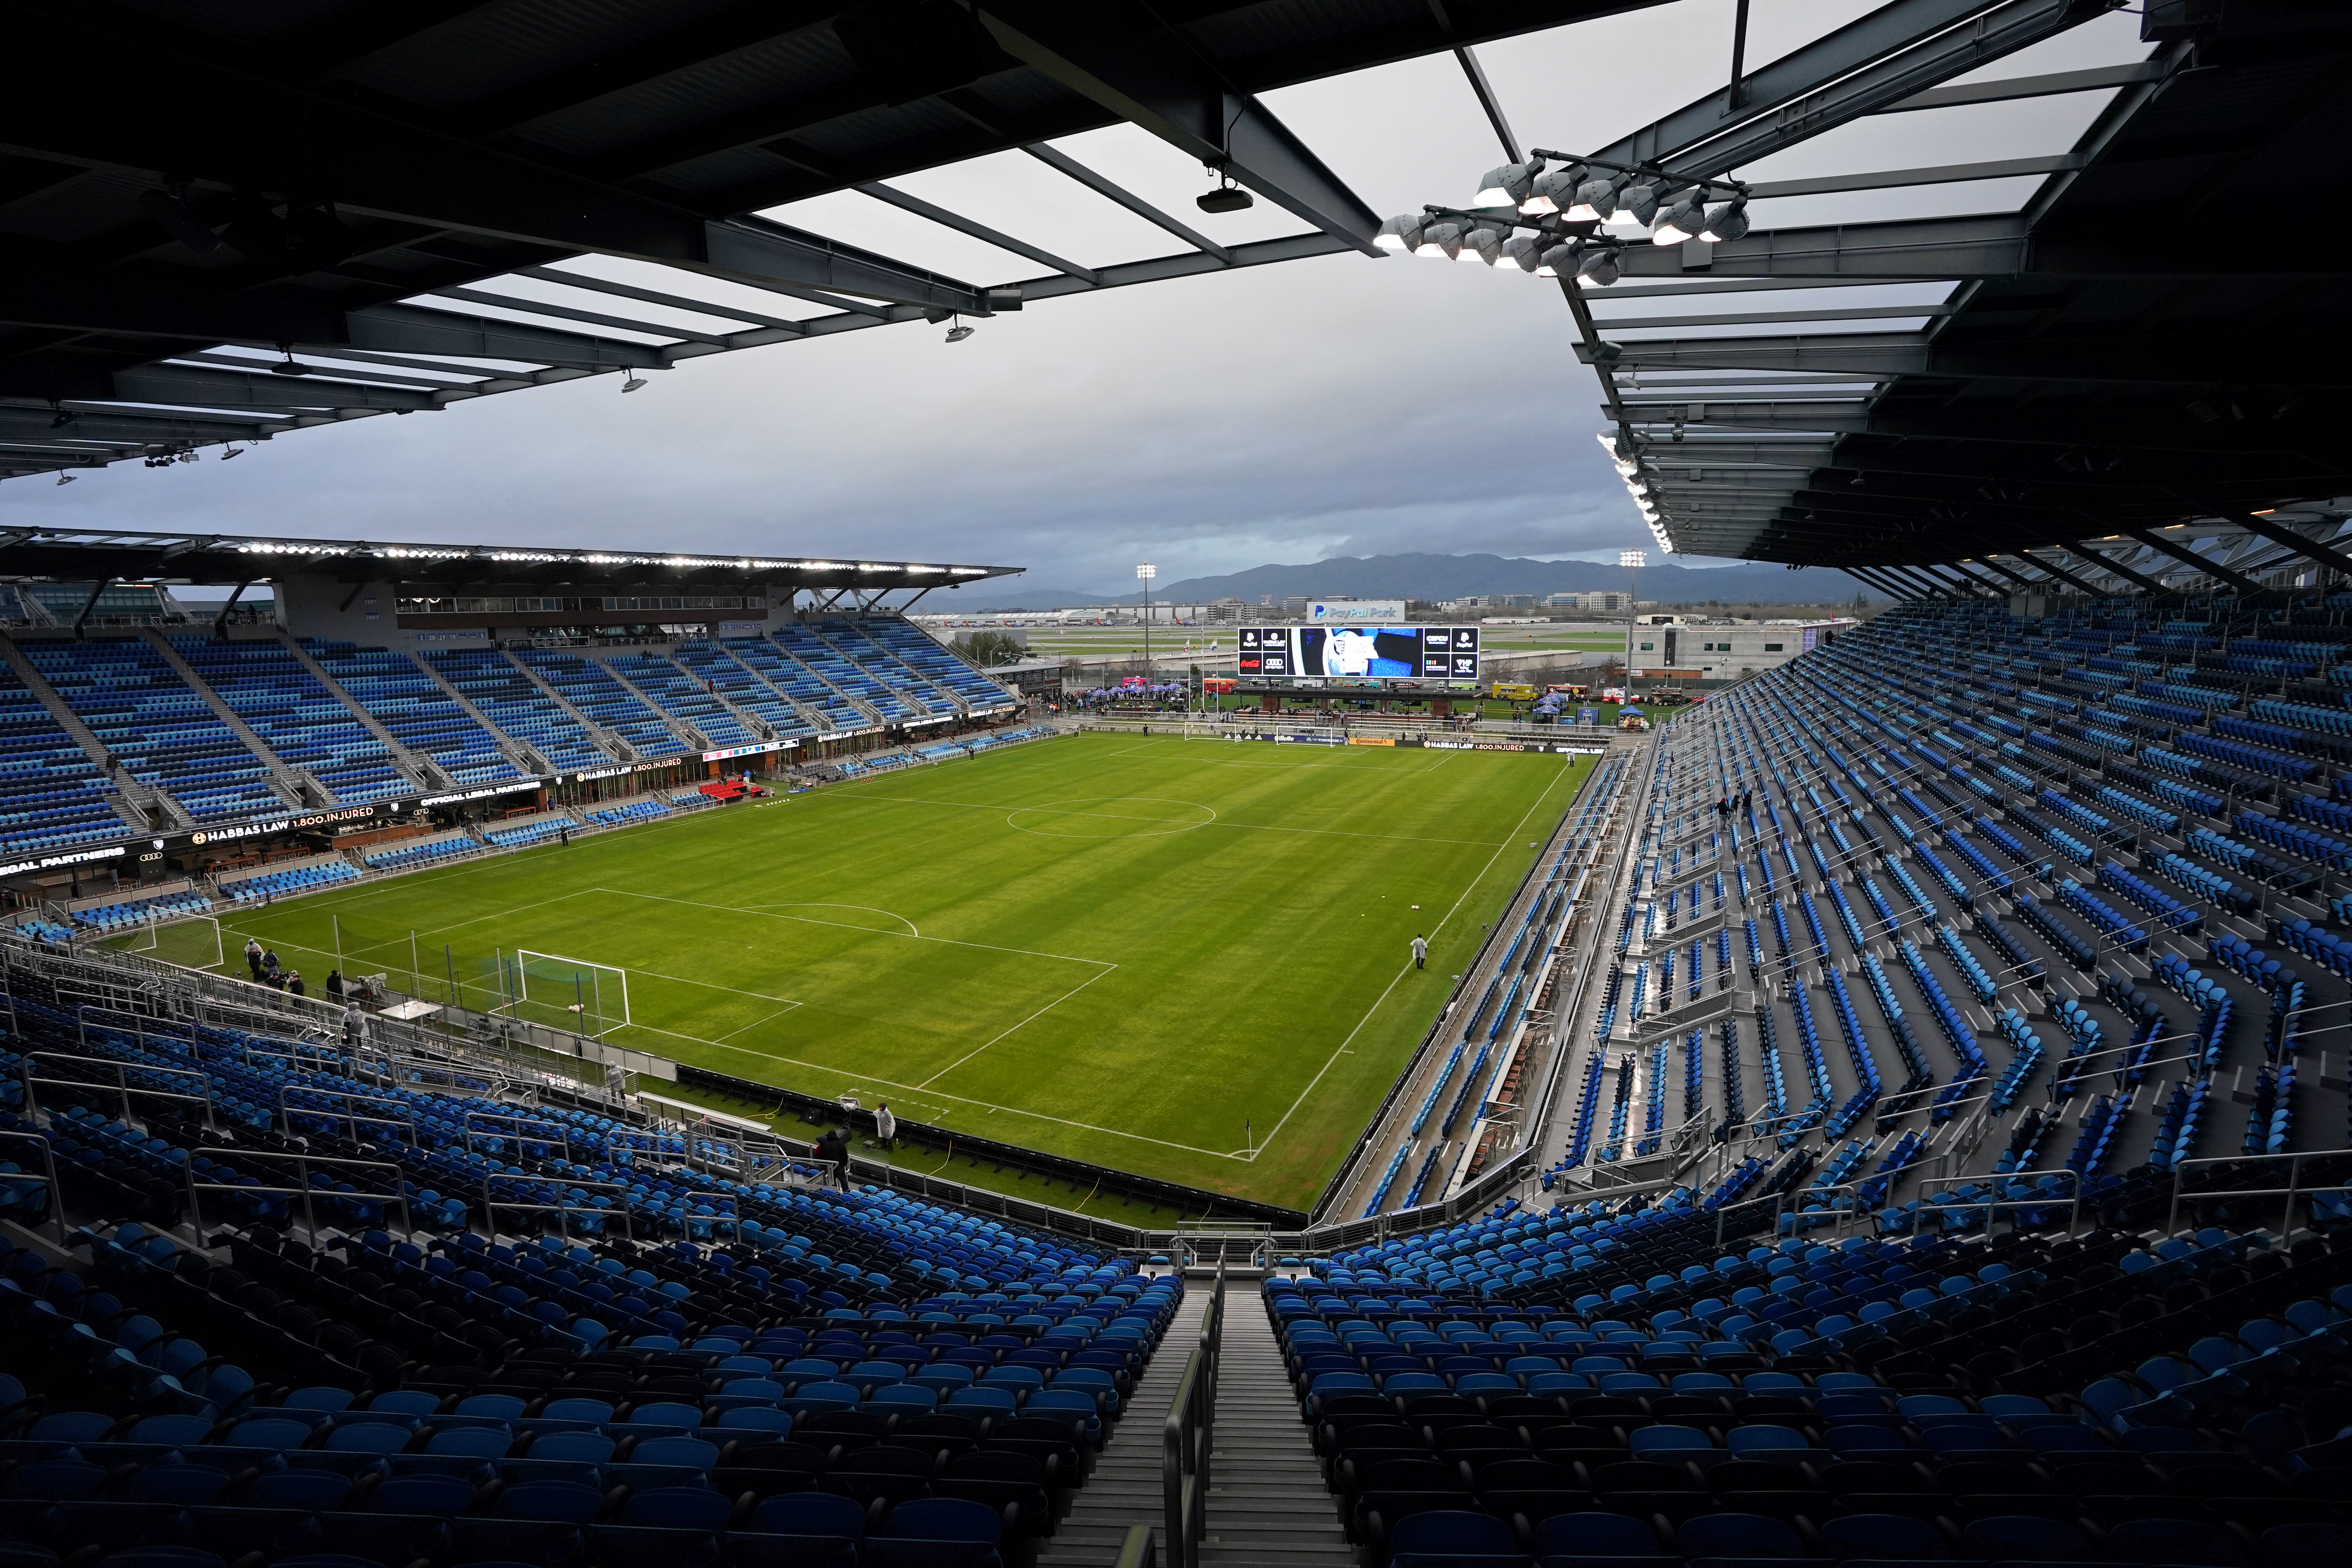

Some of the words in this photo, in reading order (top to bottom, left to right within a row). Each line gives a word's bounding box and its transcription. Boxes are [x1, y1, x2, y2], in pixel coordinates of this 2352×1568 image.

[1330, 607, 1368, 618] PayPal
[1370, 607, 1396, 617] Park
[823, 732, 842, 741] HABBAS
[853, 726, 885, 736] 1.800.INJURED
[585, 768, 615, 780] HABBAS
[617, 766, 631, 774] LAW
[633, 758, 681, 772] 1.800.INJURED
[421, 793, 465, 807] OFFICIAL
[466, 788, 496, 799] LEGAL
[496, 781, 541, 794] PARTNERS
[208, 824, 261, 842] HABBAS
[263, 820, 289, 833] LAW
[293, 807, 374, 828] 1.800.INJURED
[41, 847, 125, 867] PARTNERS
